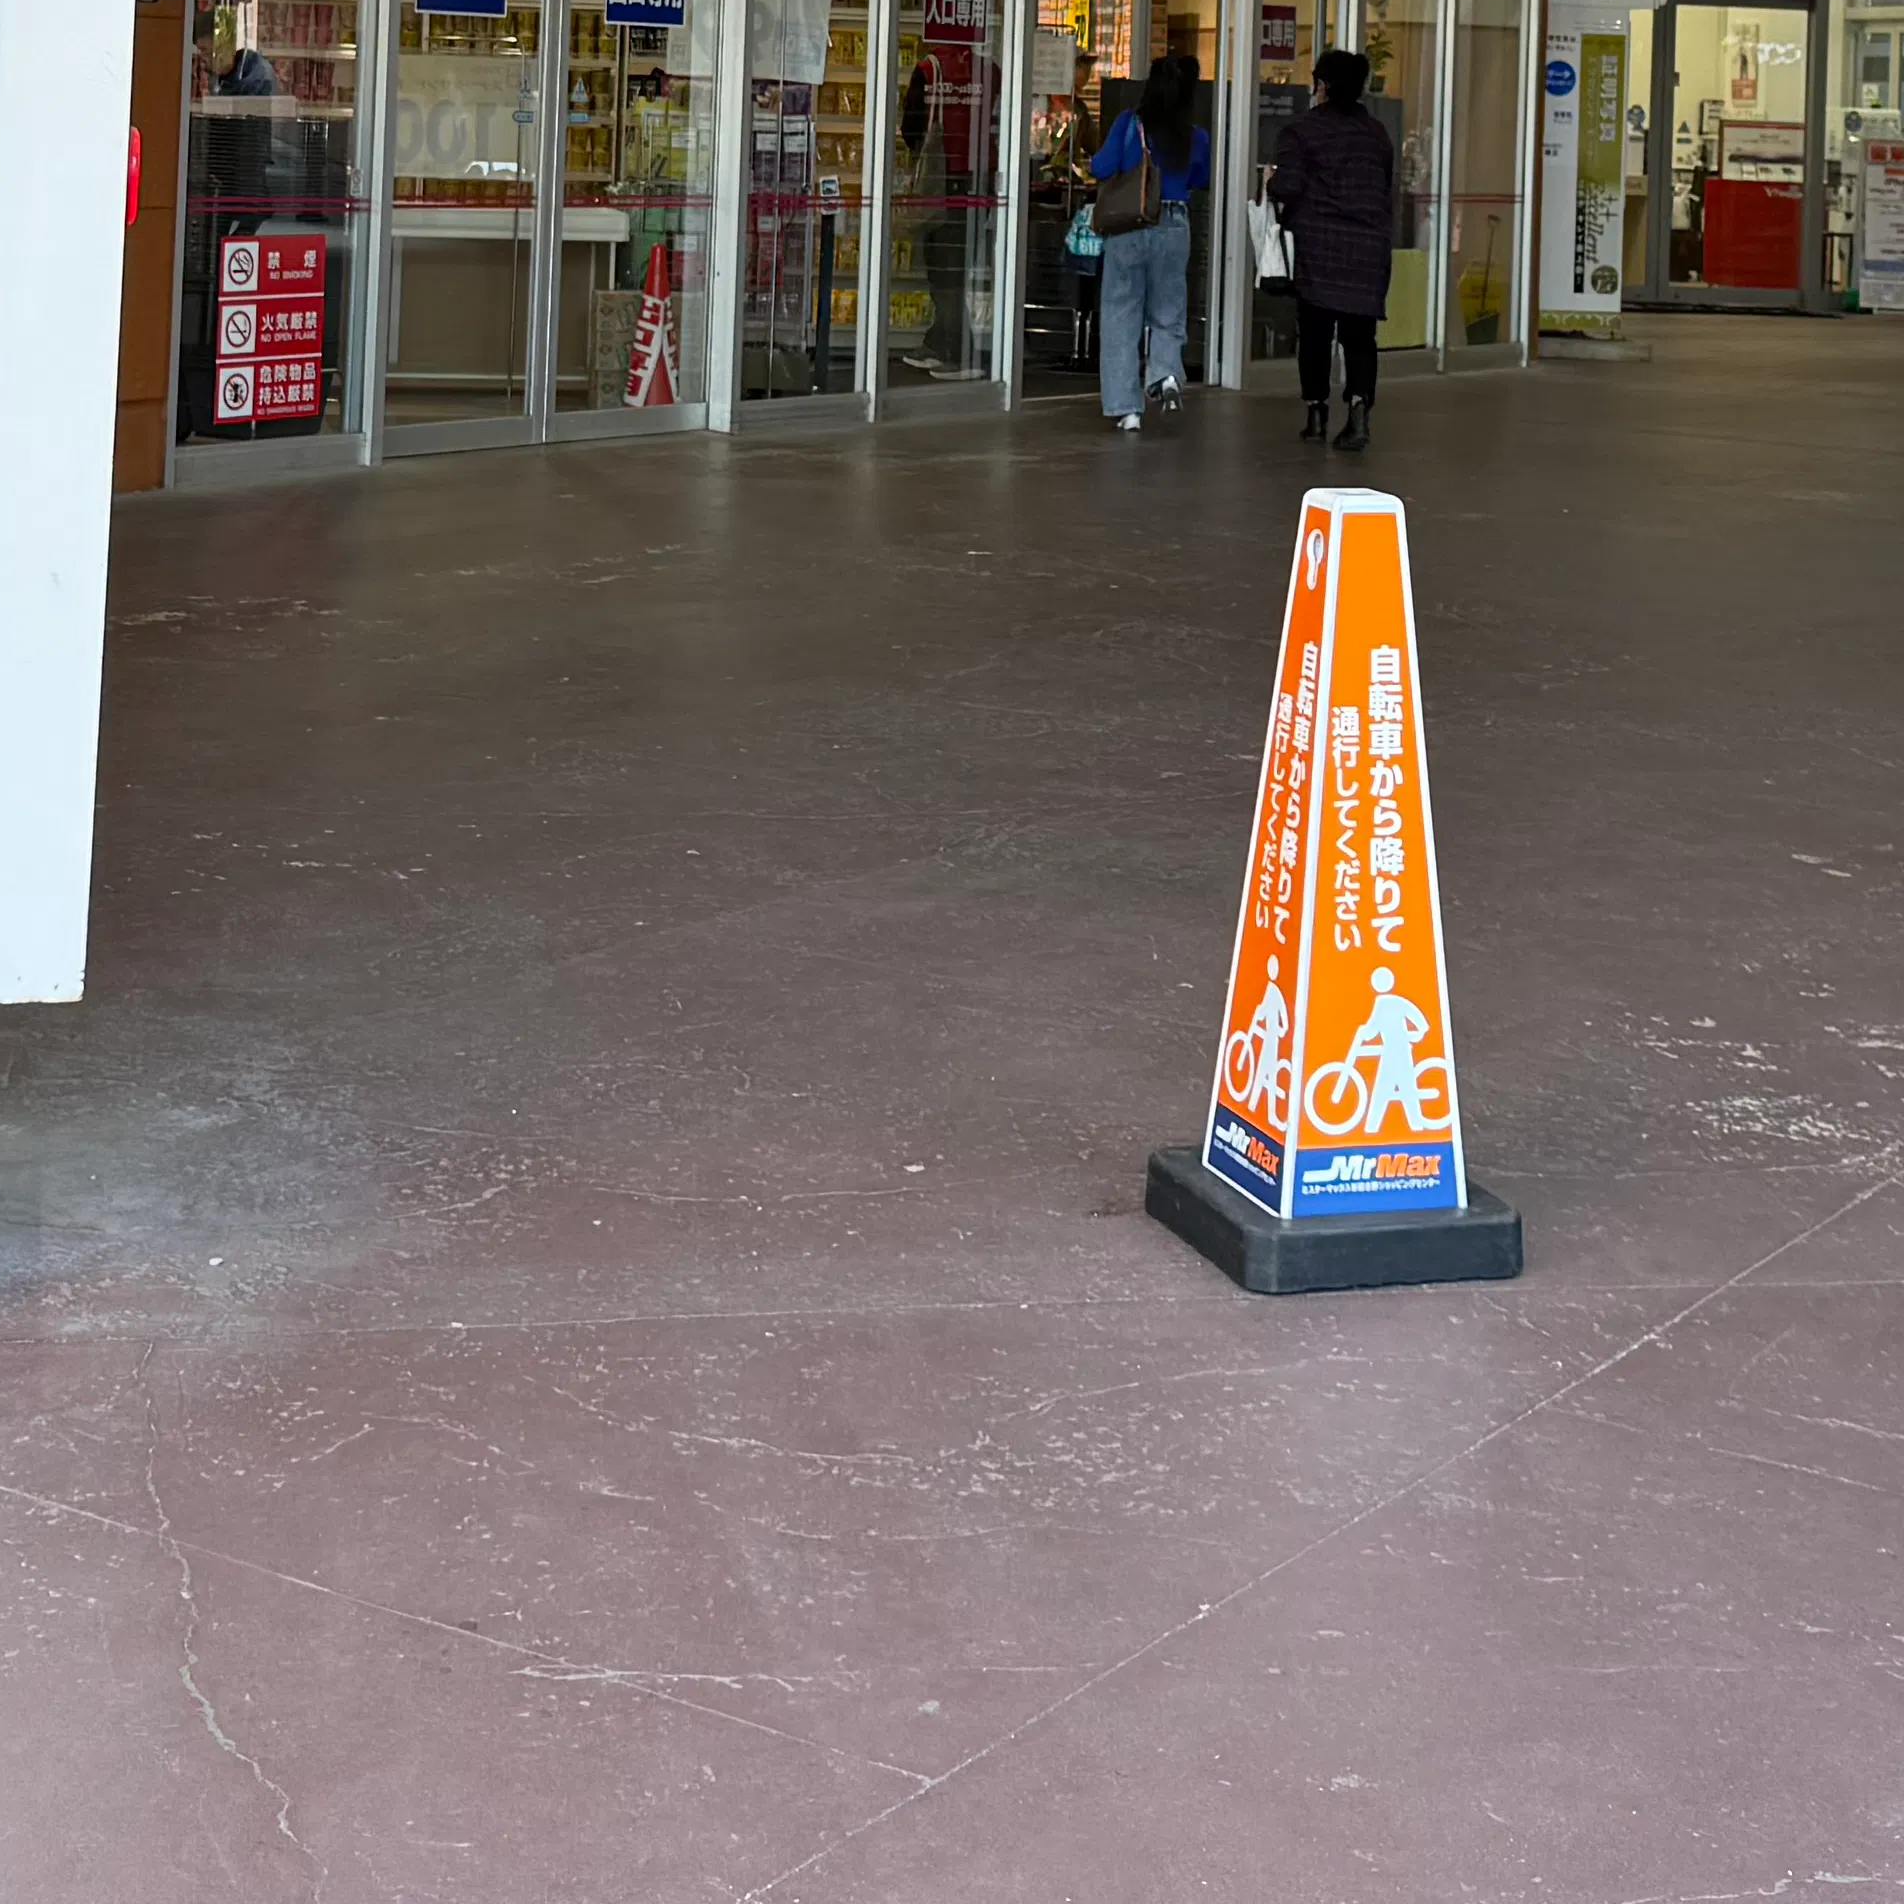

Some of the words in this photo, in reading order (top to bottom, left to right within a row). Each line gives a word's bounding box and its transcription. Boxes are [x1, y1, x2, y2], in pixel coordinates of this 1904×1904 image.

[259, 362, 316, 383] 危険物品
[261, 311, 317, 331] 火気厳禁
[1255, 691, 1295, 929] 通行してください
[1273, 640, 1319, 945] 自転車から降りて
[1331, 706, 1362, 952] 通行してください
[1368, 644, 1405, 953] 自転車から降りて
[1215, 1121, 1280, 1177] MrMax
[1302, 1153, 1441, 1183] MrMax
